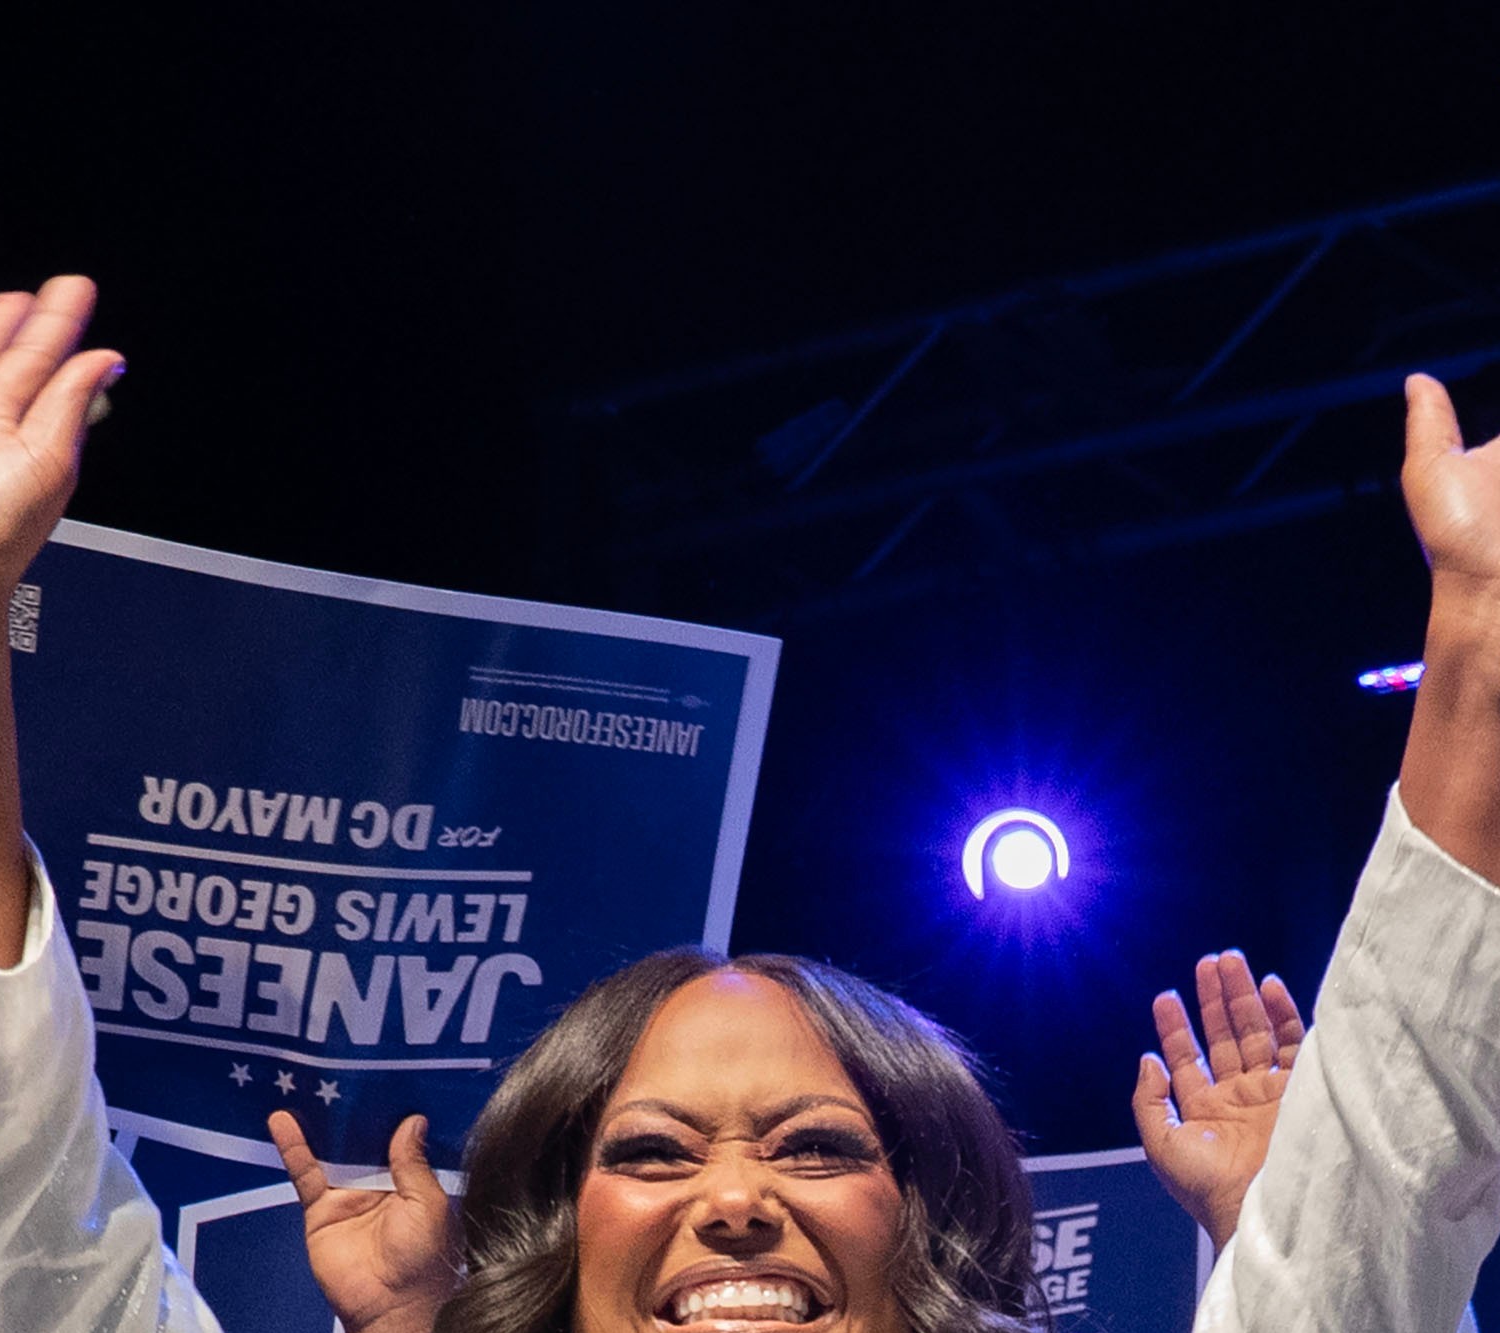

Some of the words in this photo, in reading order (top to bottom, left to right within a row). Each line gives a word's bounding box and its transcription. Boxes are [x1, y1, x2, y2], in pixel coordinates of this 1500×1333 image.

[460, 697, 705, 757] JANEESEFORDC.COM
[138, 776, 342, 843] MAYOR
[349, 802, 435, 852] DC
[437, 823, 502, 850] FOR
[79, 861, 316, 936] GEORGE
[337, 890, 528, 943] LEWIS
[74, 919, 543, 1047] JANEESE
